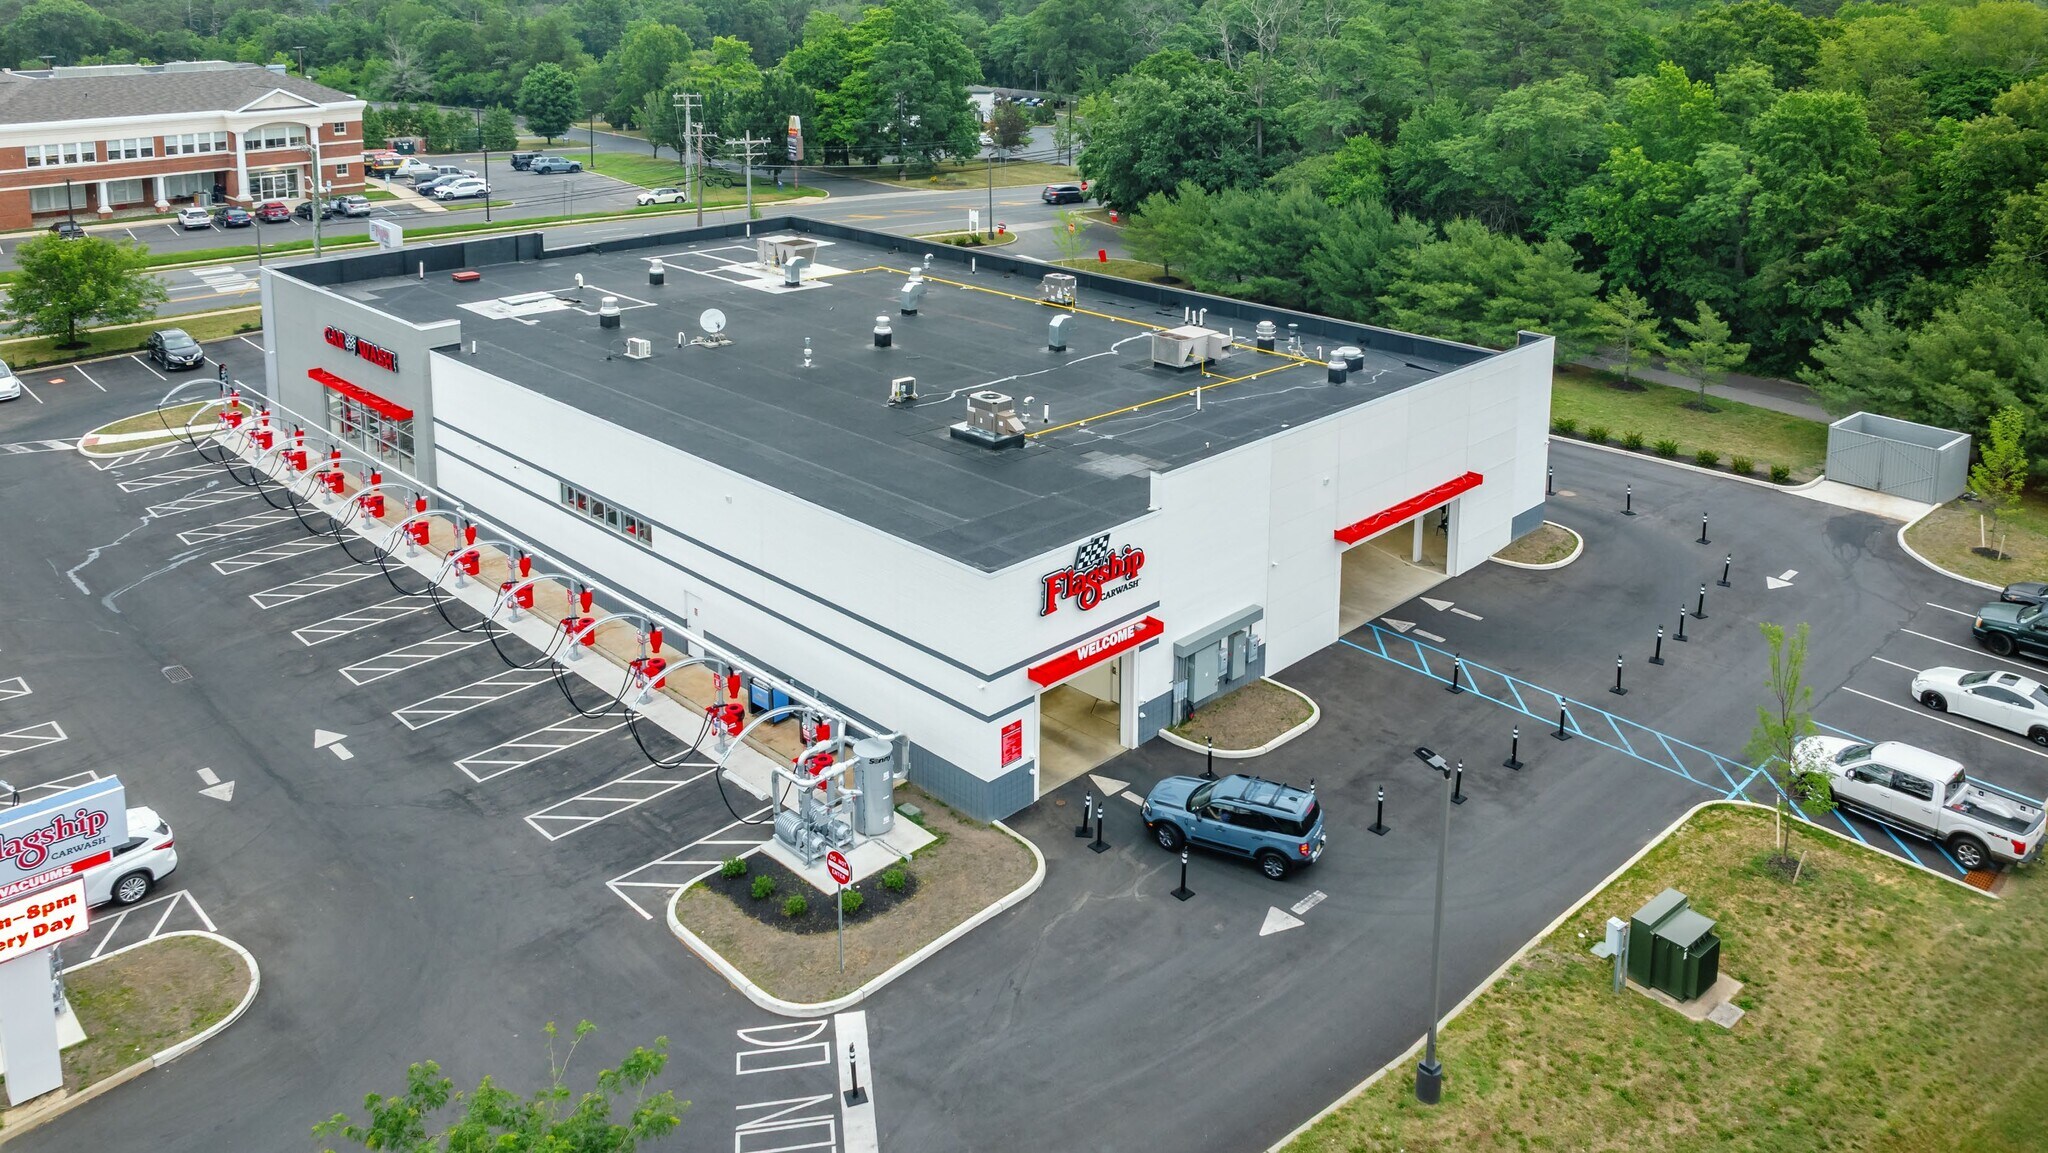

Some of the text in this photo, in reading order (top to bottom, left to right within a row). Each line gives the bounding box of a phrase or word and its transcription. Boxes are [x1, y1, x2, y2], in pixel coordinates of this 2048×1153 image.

[324, 325, 397, 373] CAR WASH
[1041, 544, 1145, 616] Flagship
[1101, 579, 1139, 601] CARWASH
[1077, 624, 1135, 661] WELCOME
[0, 808, 109, 871] lagship
[829, 854, 847, 867] DO NOT
[831, 868, 846, 881] ENTER
[0, 865, 73, 899] VACUUMS
[0, 915, 75, 952] ery Day
[735, 1093, 837, 1153] NO
